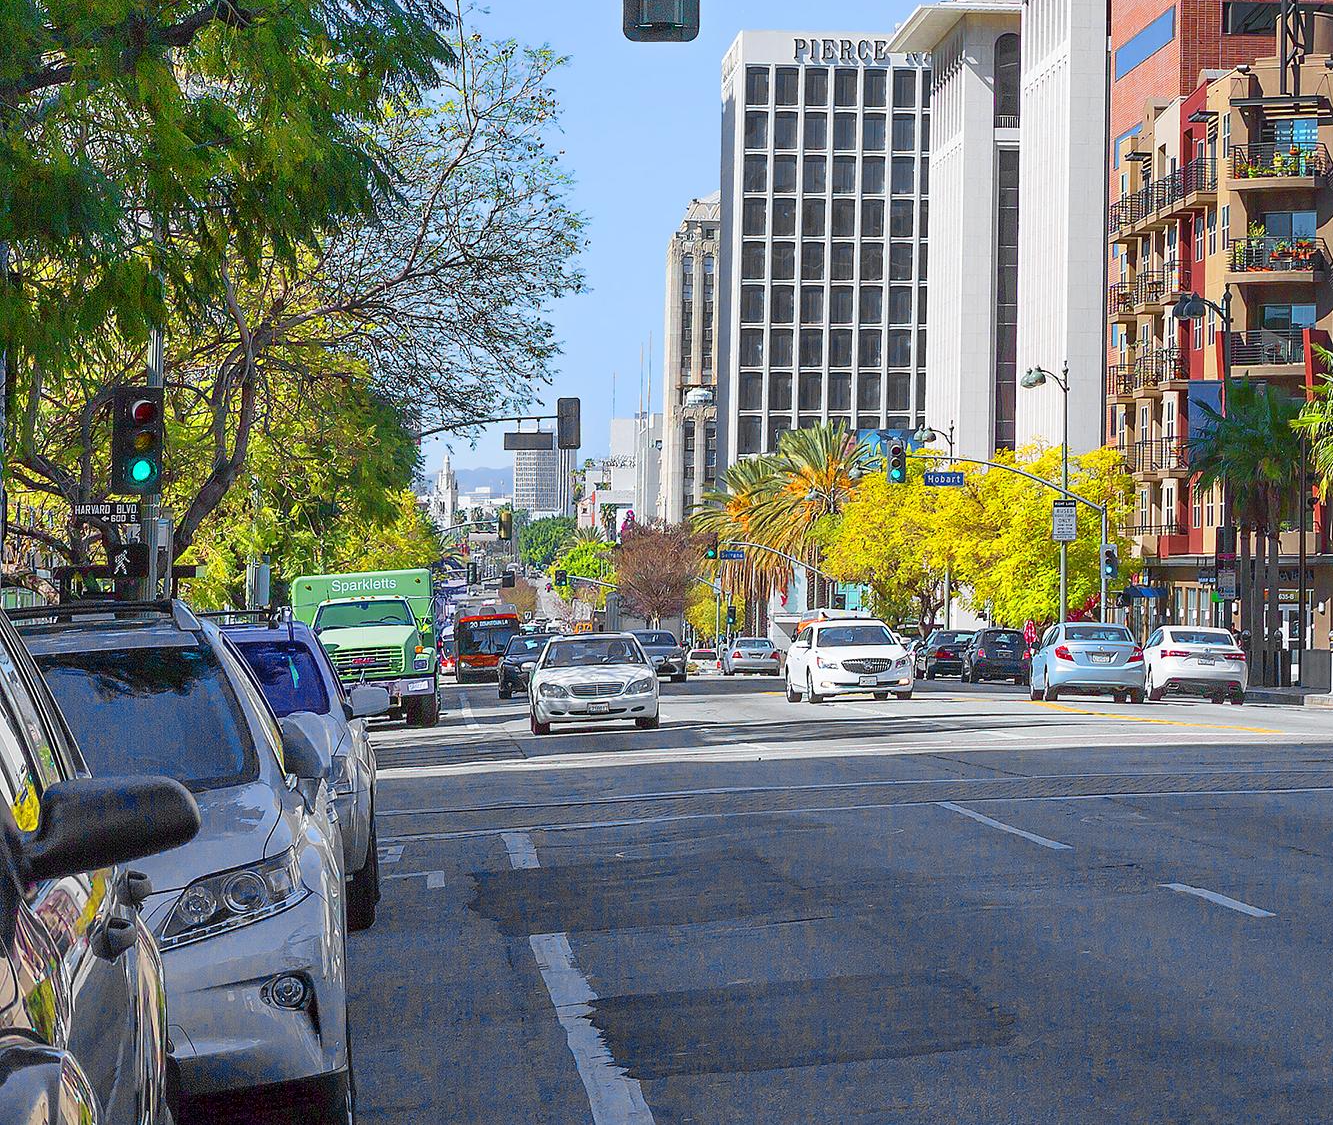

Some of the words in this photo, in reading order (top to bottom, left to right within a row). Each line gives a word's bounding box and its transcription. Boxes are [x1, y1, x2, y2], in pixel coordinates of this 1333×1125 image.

[793, 38, 887, 62] PIERCE
[927, 475, 961, 484] Hobart
[74, 504, 111, 514] HARVARD
[116, 503, 139, 514] BLVD.
[110, 514, 127, 523] 600
[331, 577, 397, 593] Sparkletts
[469, 621, 478, 629] 20
